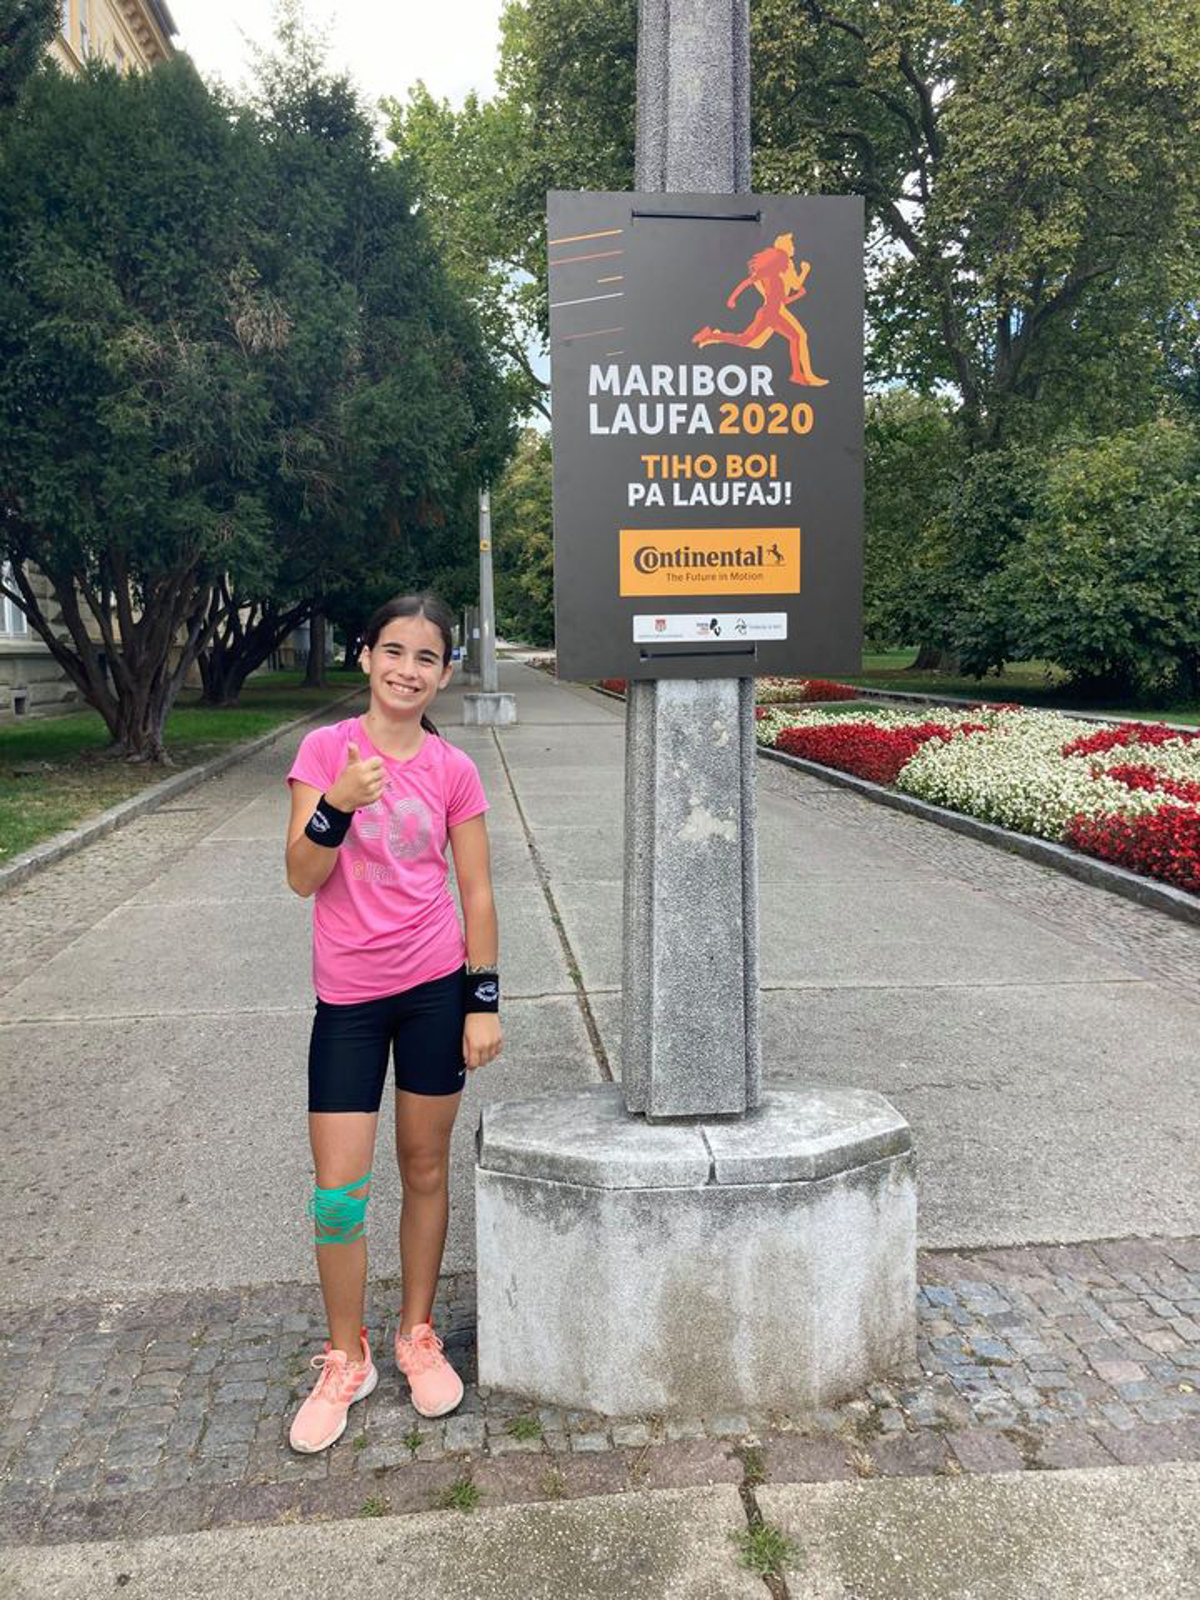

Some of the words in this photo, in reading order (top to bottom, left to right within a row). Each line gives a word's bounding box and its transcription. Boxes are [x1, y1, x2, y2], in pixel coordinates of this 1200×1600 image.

[588, 364, 774, 396] MARIBOR
[589, 403, 714, 435] LAUFA
[719, 402, 814, 435] 2020
[641, 454, 718, 480] TIHO
[726, 454, 778, 479] BOI
[628, 482, 665, 507] PA
[673, 482, 792, 506] LAUFAJ!
[634, 545, 763, 574] Continental
[666, 572, 683, 582] The
[686, 571, 715, 582] Future
[718, 571, 729, 581] in
[730, 571, 763, 581] Motion
